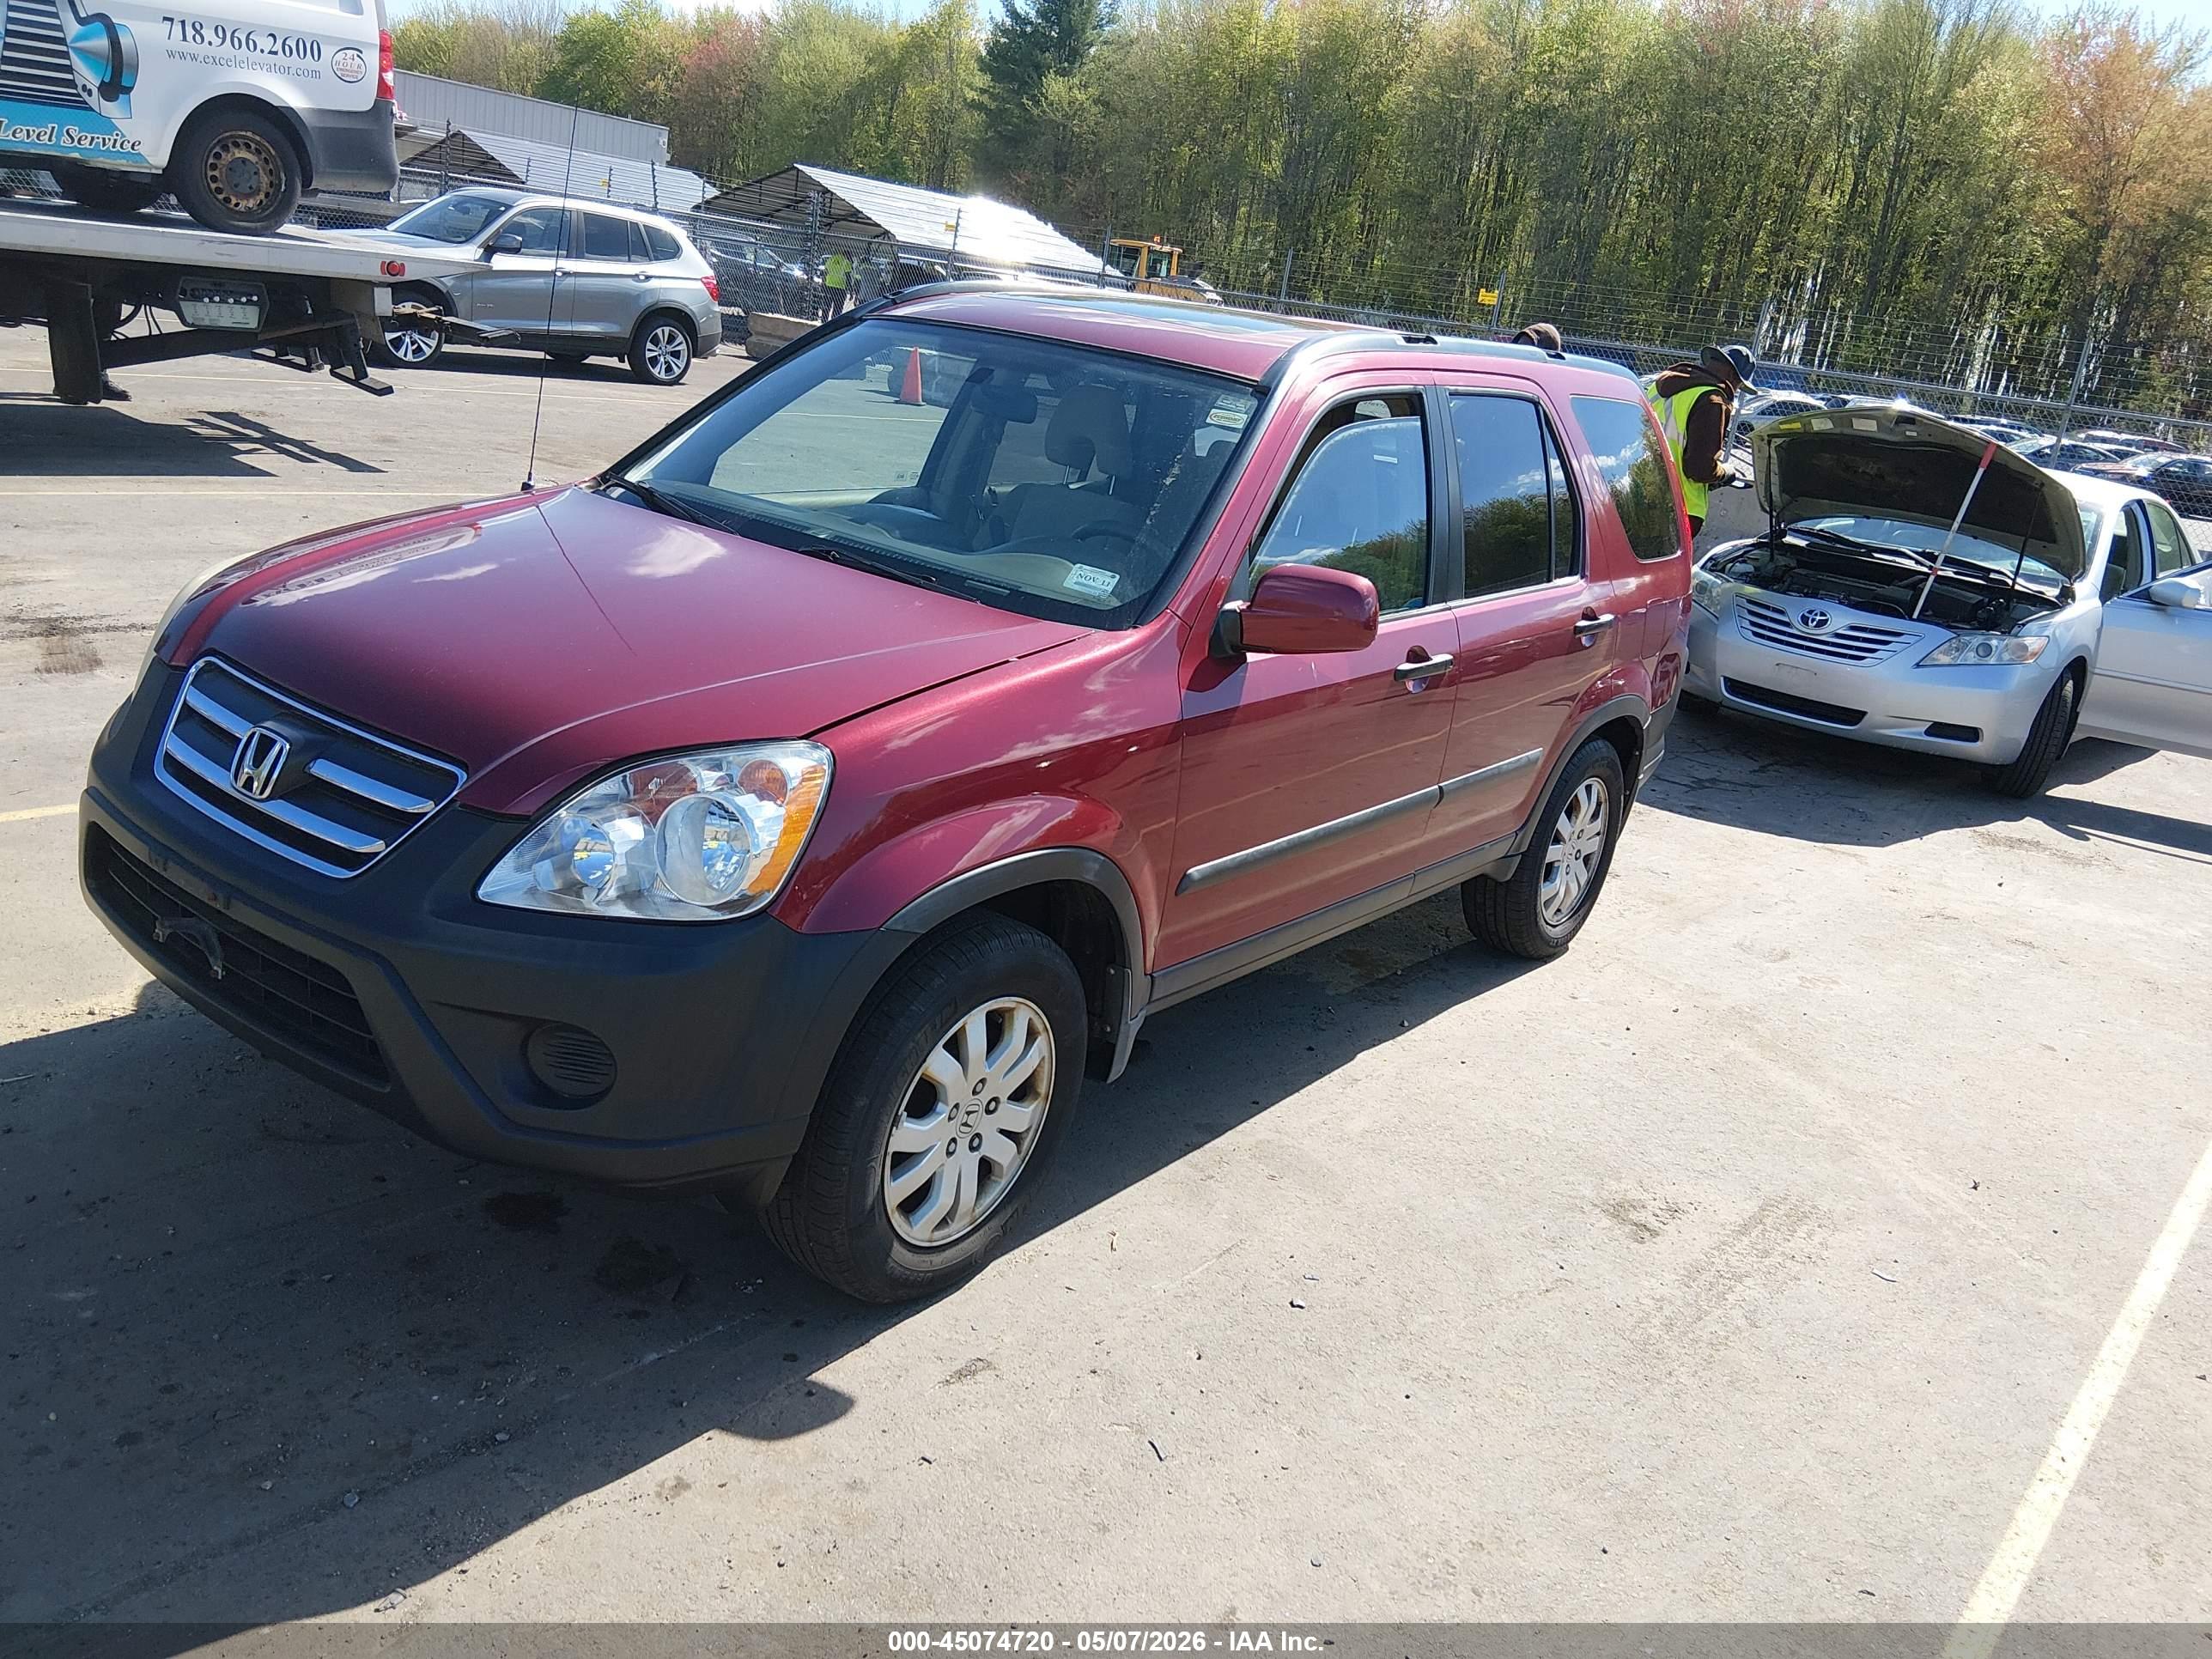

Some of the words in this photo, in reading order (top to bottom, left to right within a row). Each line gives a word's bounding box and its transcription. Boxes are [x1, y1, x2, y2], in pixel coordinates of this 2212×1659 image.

[161, 15, 322, 63] 718.966.2600
[166, 49, 321, 80] www.excelelevator.com
[342, 52, 355, 62] 24
[0, 119, 56, 143] Level
[63, 127, 142, 151] Service
[1077, 571, 1099, 582] NOV
